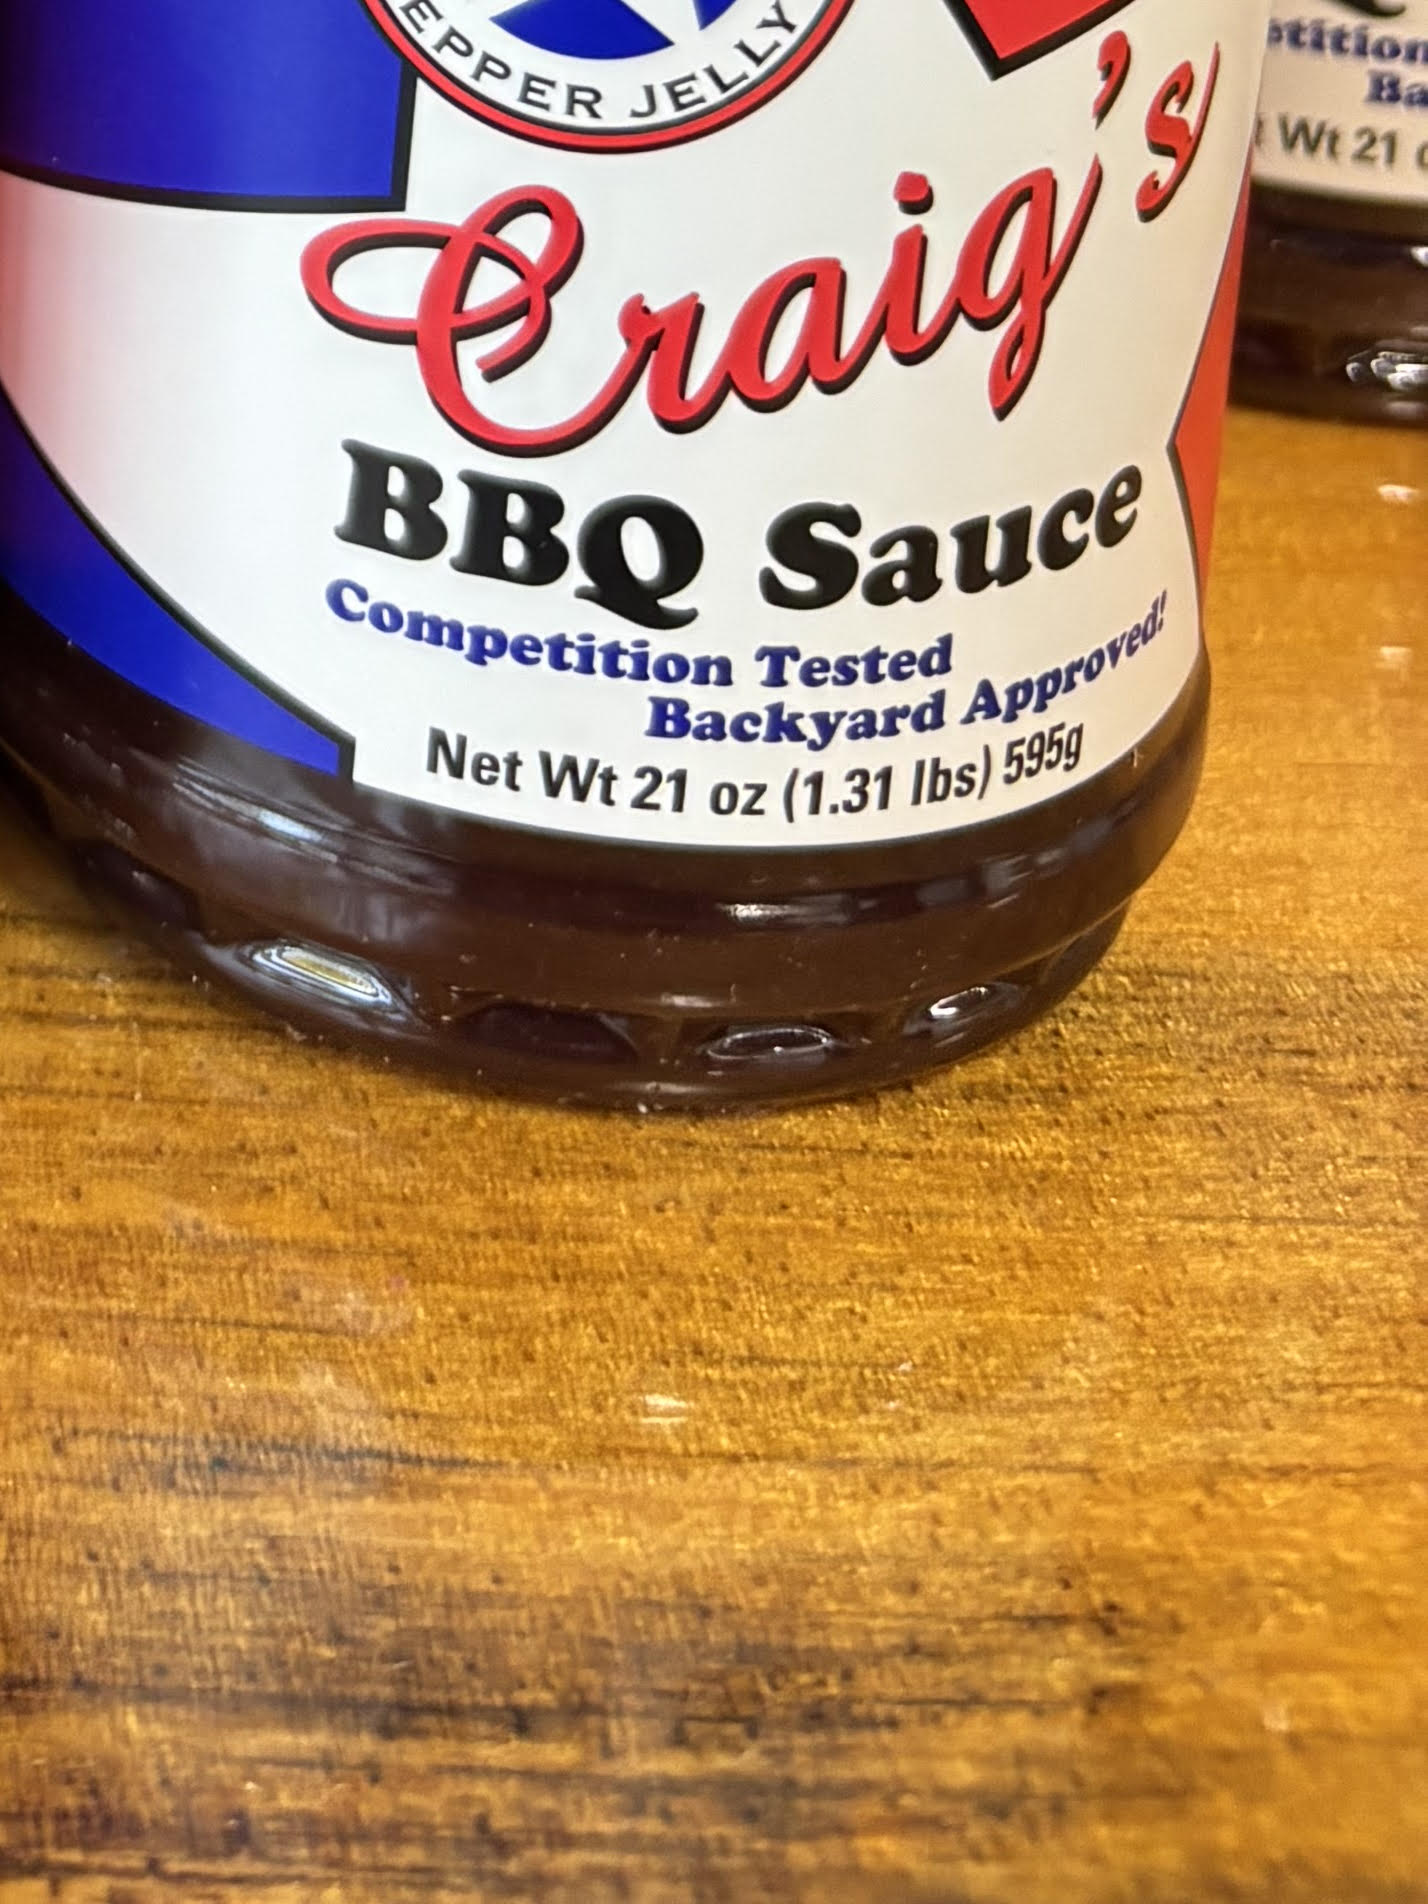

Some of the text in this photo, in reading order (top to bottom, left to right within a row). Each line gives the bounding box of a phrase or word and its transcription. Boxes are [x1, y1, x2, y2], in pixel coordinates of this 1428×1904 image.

[1351, 125, 1398, 168] 21
[299, 31, 1220, 459] Craig's
[334, 439, 1142, 631] BBQ Sauce
[325, 578, 954, 689] Competition Tested
[645, 589, 1168, 751] Backyard Approved!
[426, 722, 1086, 823] Net Wt 21 oz (1.31 lbs) 595g
